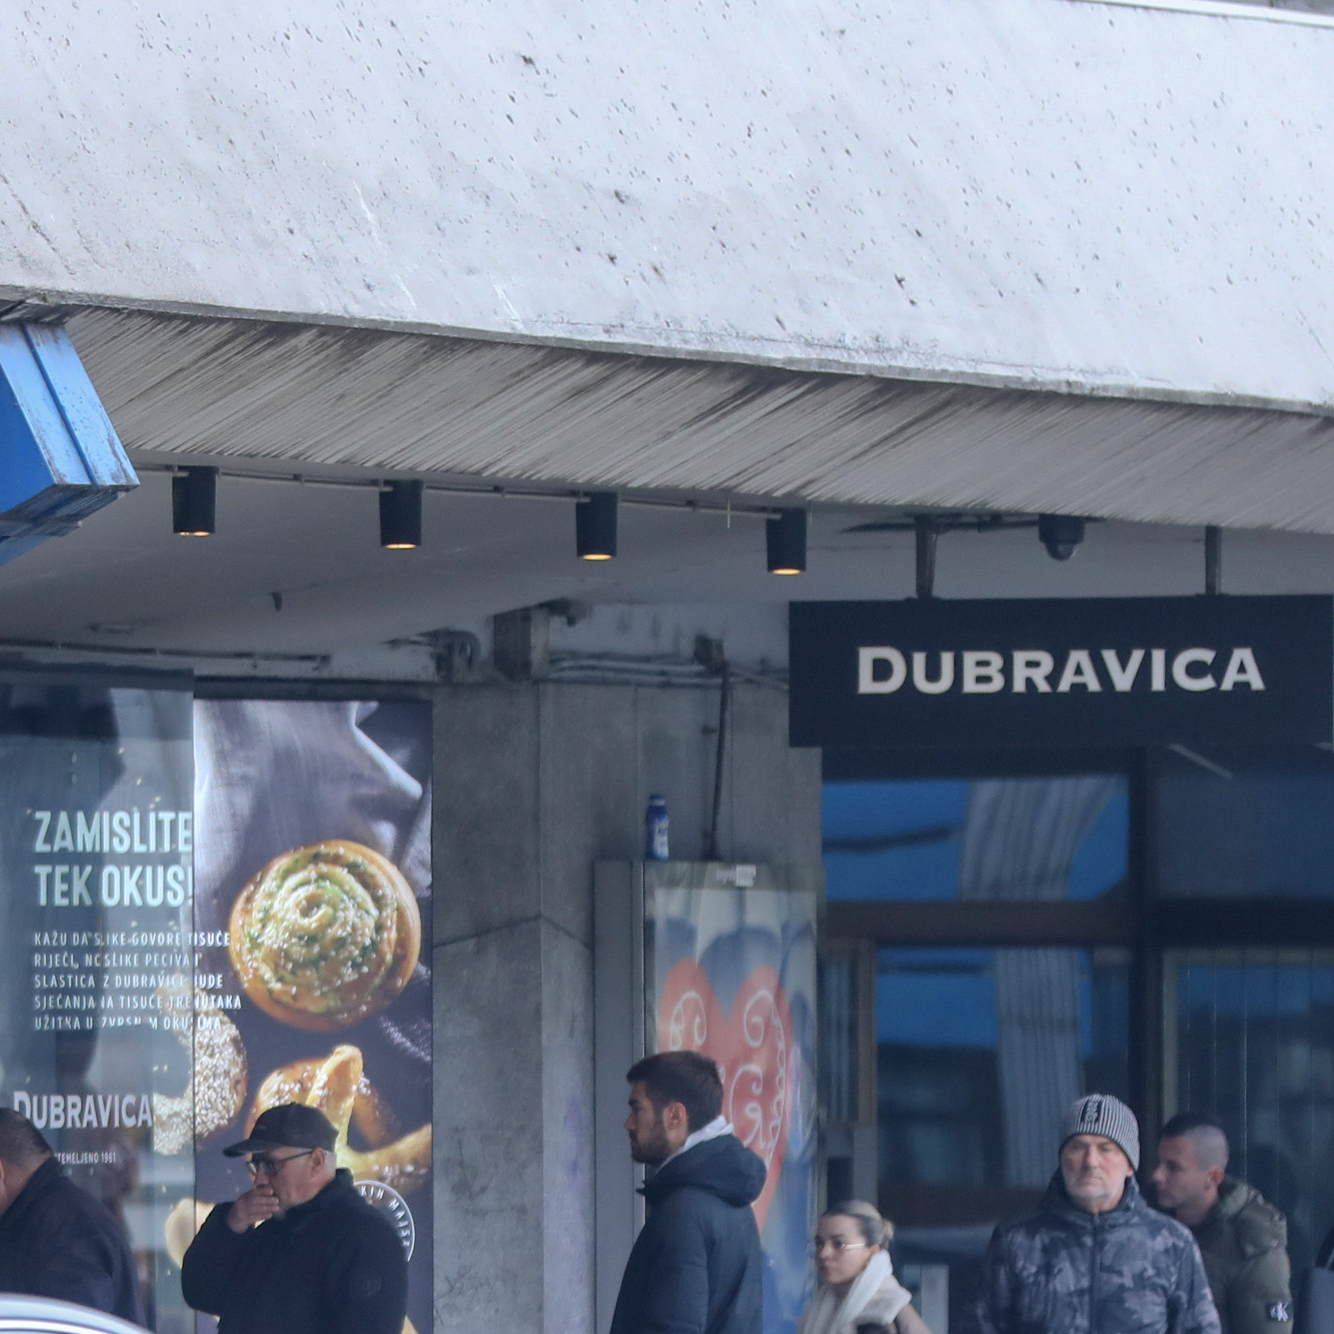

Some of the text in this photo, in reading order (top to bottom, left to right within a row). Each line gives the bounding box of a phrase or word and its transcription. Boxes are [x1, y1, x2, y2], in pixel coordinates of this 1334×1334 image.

[857, 646, 1265, 694] DUBRAVICA
[34, 810, 192, 853] ZAMISLITE
[34, 865, 92, 907] TEK
[34, 930, 68, 946] KAŽU
[131, 932, 182, 946] GOVORE
[104, 952, 139, 968] SLIKE
[145, 952, 191, 968] PECIVA
[34, 974, 96, 989] SLASTICA
[119, 994, 164, 1010] TISUĆE
[14, 1091, 153, 1129] DUBRAVICA
[55, 1152, 99, 1165] TEMELJENO
